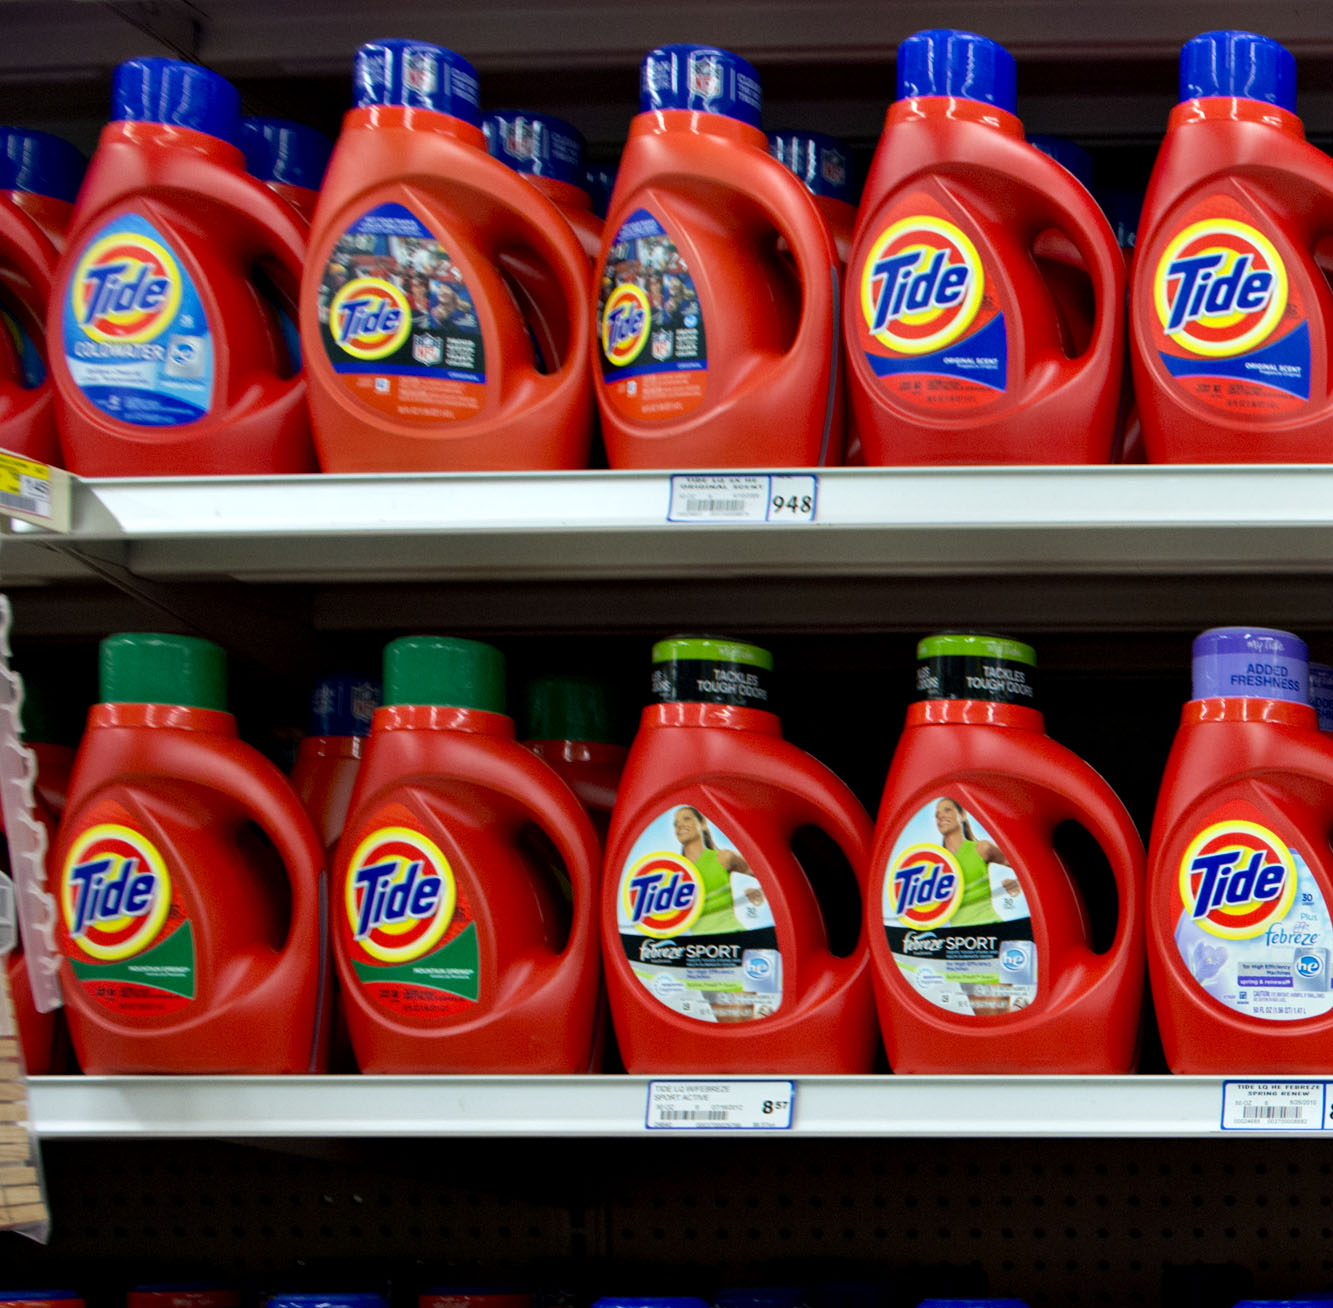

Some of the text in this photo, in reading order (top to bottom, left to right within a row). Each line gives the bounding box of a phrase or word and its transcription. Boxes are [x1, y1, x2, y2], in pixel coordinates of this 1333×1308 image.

[76, 262, 170, 327] Tide
[869, 249, 972, 334] Tide
[1165, 251, 1275, 335] Tide
[338, 295, 405, 344] Tide
[605, 305, 645, 354] Tide
[1230, 673, 1300, 692] FRESHNESS
[1246, 663, 1289, 678] ADDED
[68, 857, 158, 939] Tide
[353, 860, 443, 941] Tide
[629, 870, 697, 922] Tide
[895, 864, 956, 915] Tide
[1190, 850, 1285, 920] Tide
[686, 944, 741, 959] SPORT
[946, 936, 997, 951] SPORT
[1265, 926, 1318, 947] febreze
